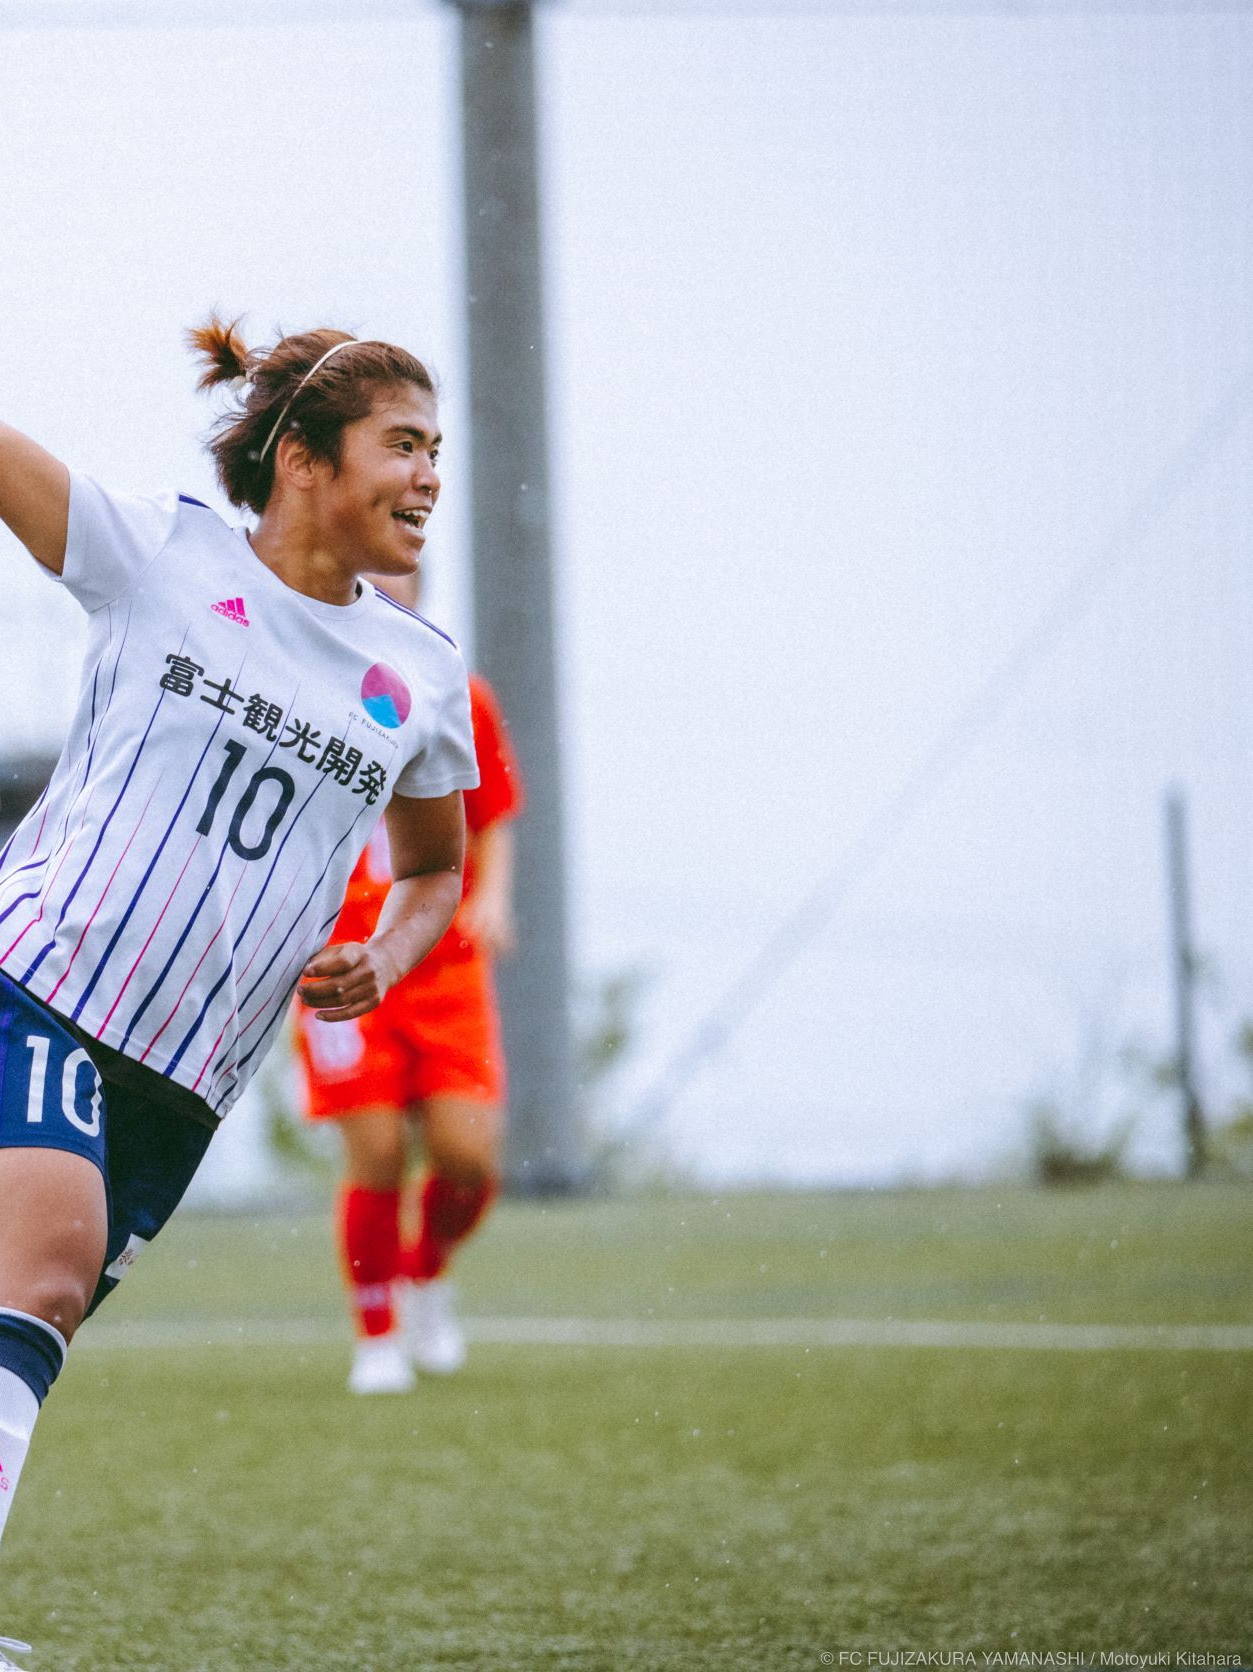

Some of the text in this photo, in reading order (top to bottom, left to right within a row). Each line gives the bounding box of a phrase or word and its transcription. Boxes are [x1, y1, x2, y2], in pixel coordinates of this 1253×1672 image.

[210, 604, 250, 628] adidas
[159, 653, 388, 806] 富士観光開発
[195, 738, 296, 861] 10
[26, 1035, 104, 1138] 10
